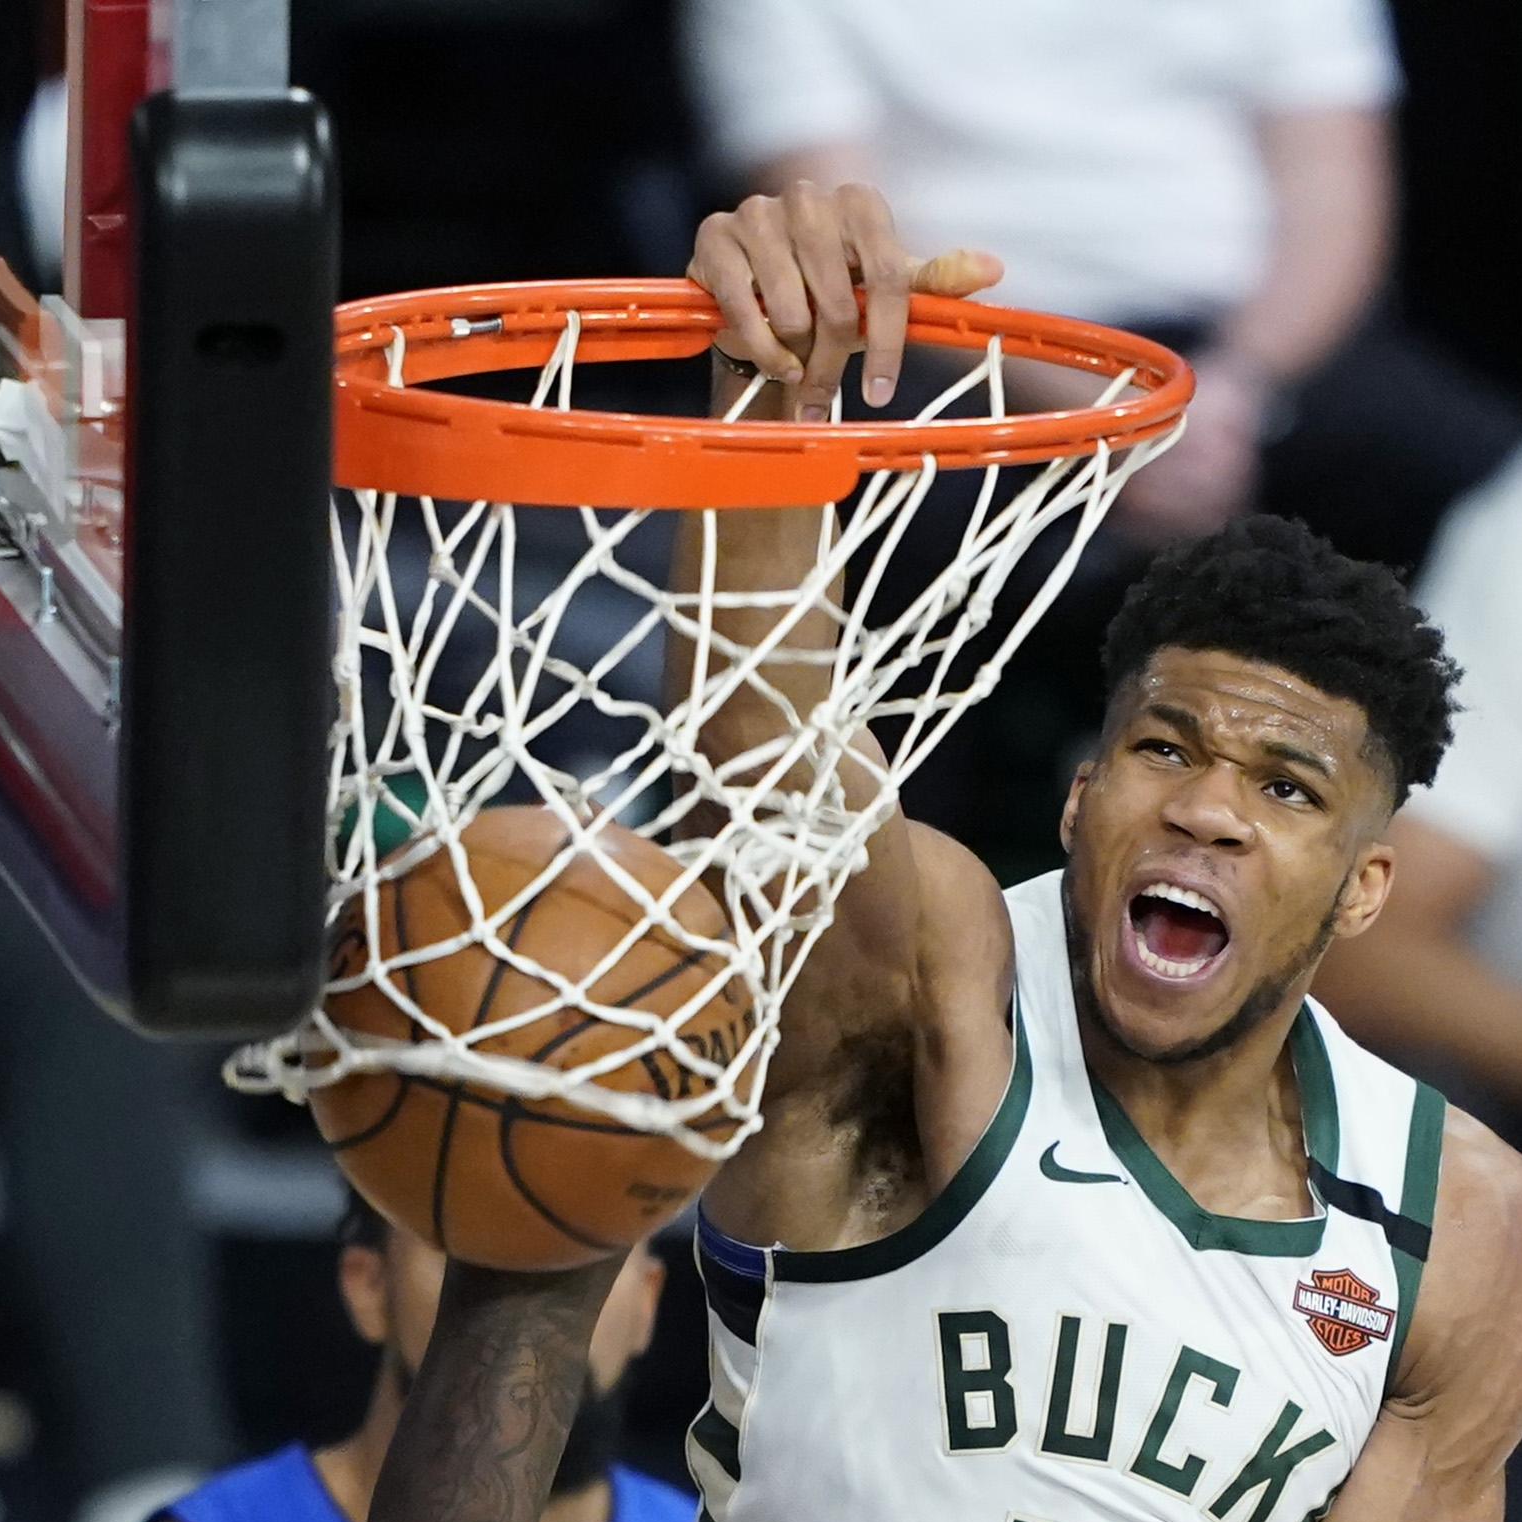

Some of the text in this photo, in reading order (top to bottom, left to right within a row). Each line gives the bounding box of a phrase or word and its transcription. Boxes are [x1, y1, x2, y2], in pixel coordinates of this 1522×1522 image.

[1321, 1275, 1372, 1304] MOTOR
[1297, 1288, 1391, 1335] HARLEY-DAVIDSON
[1315, 1318, 1363, 1350] CYCLES
